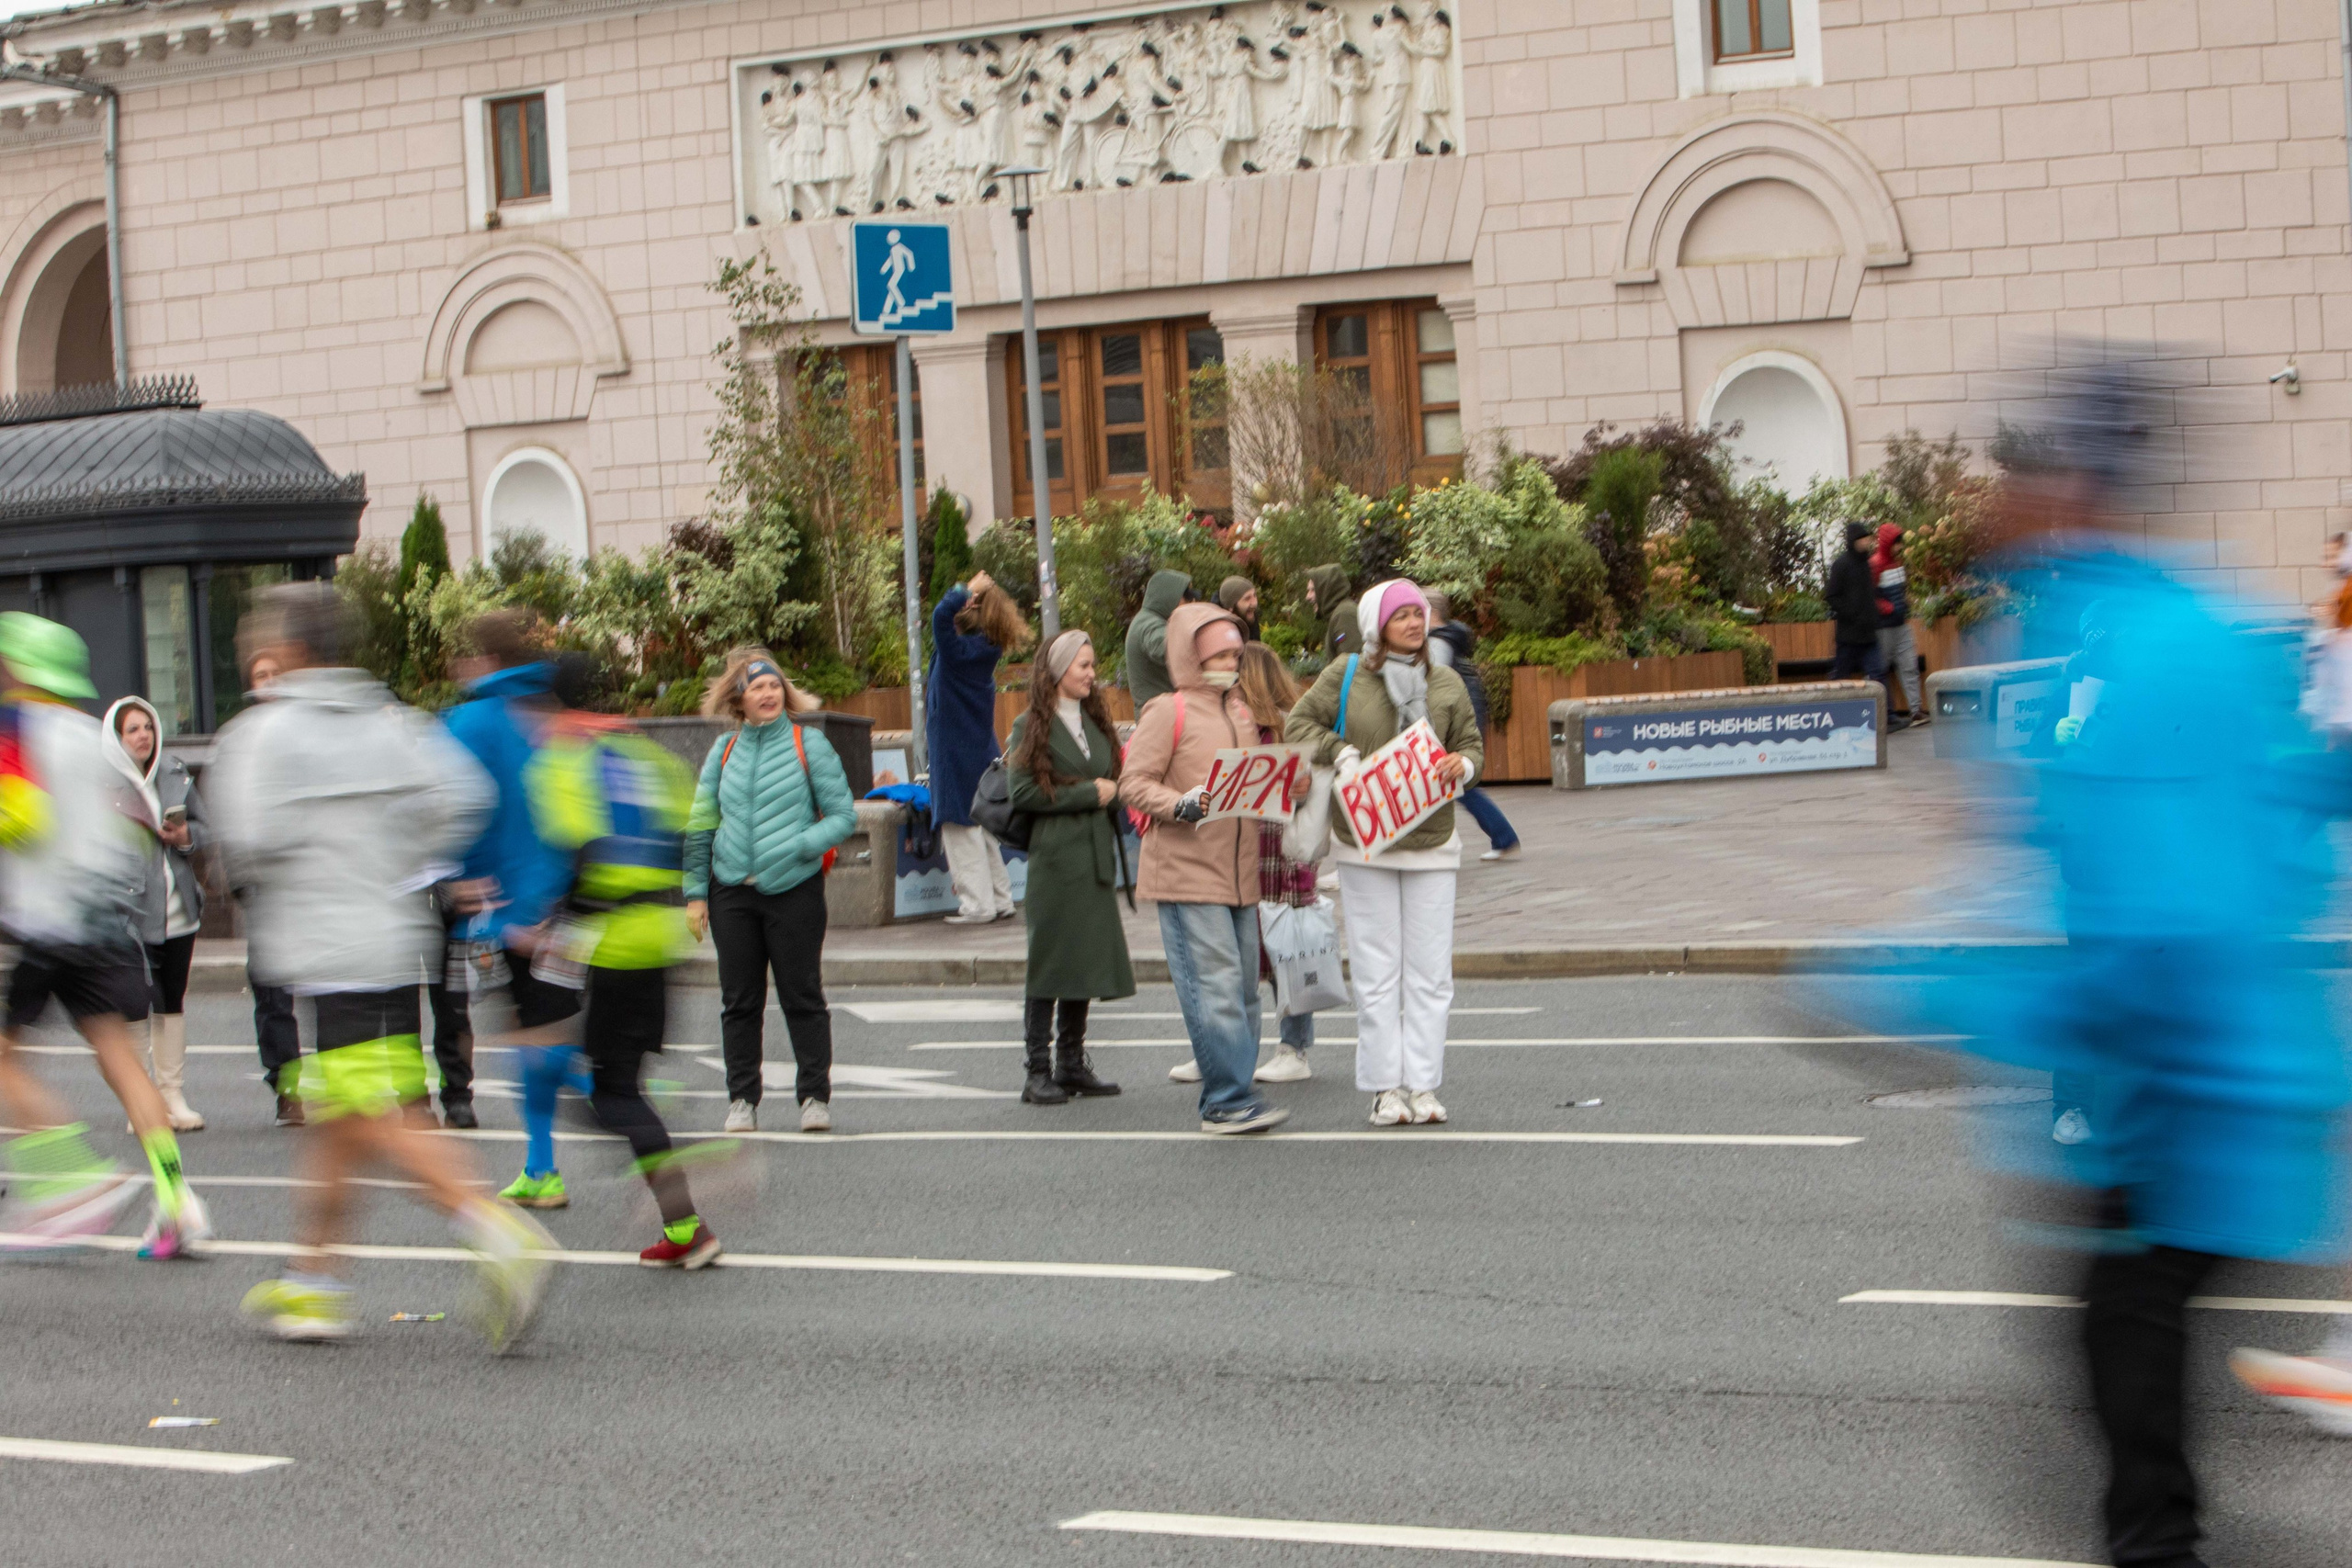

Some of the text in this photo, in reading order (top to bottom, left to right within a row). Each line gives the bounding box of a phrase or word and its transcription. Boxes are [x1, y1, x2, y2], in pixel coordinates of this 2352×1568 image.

[1633, 720, 1696, 741] НОВЫЕ
[1699, 715, 1773, 737] РЫБНЫЕ
[1776, 711, 1835, 731] МЕСТА
[1205, 752, 1300, 815] ИРА
[1277, 946, 1338, 964] ZARINA
